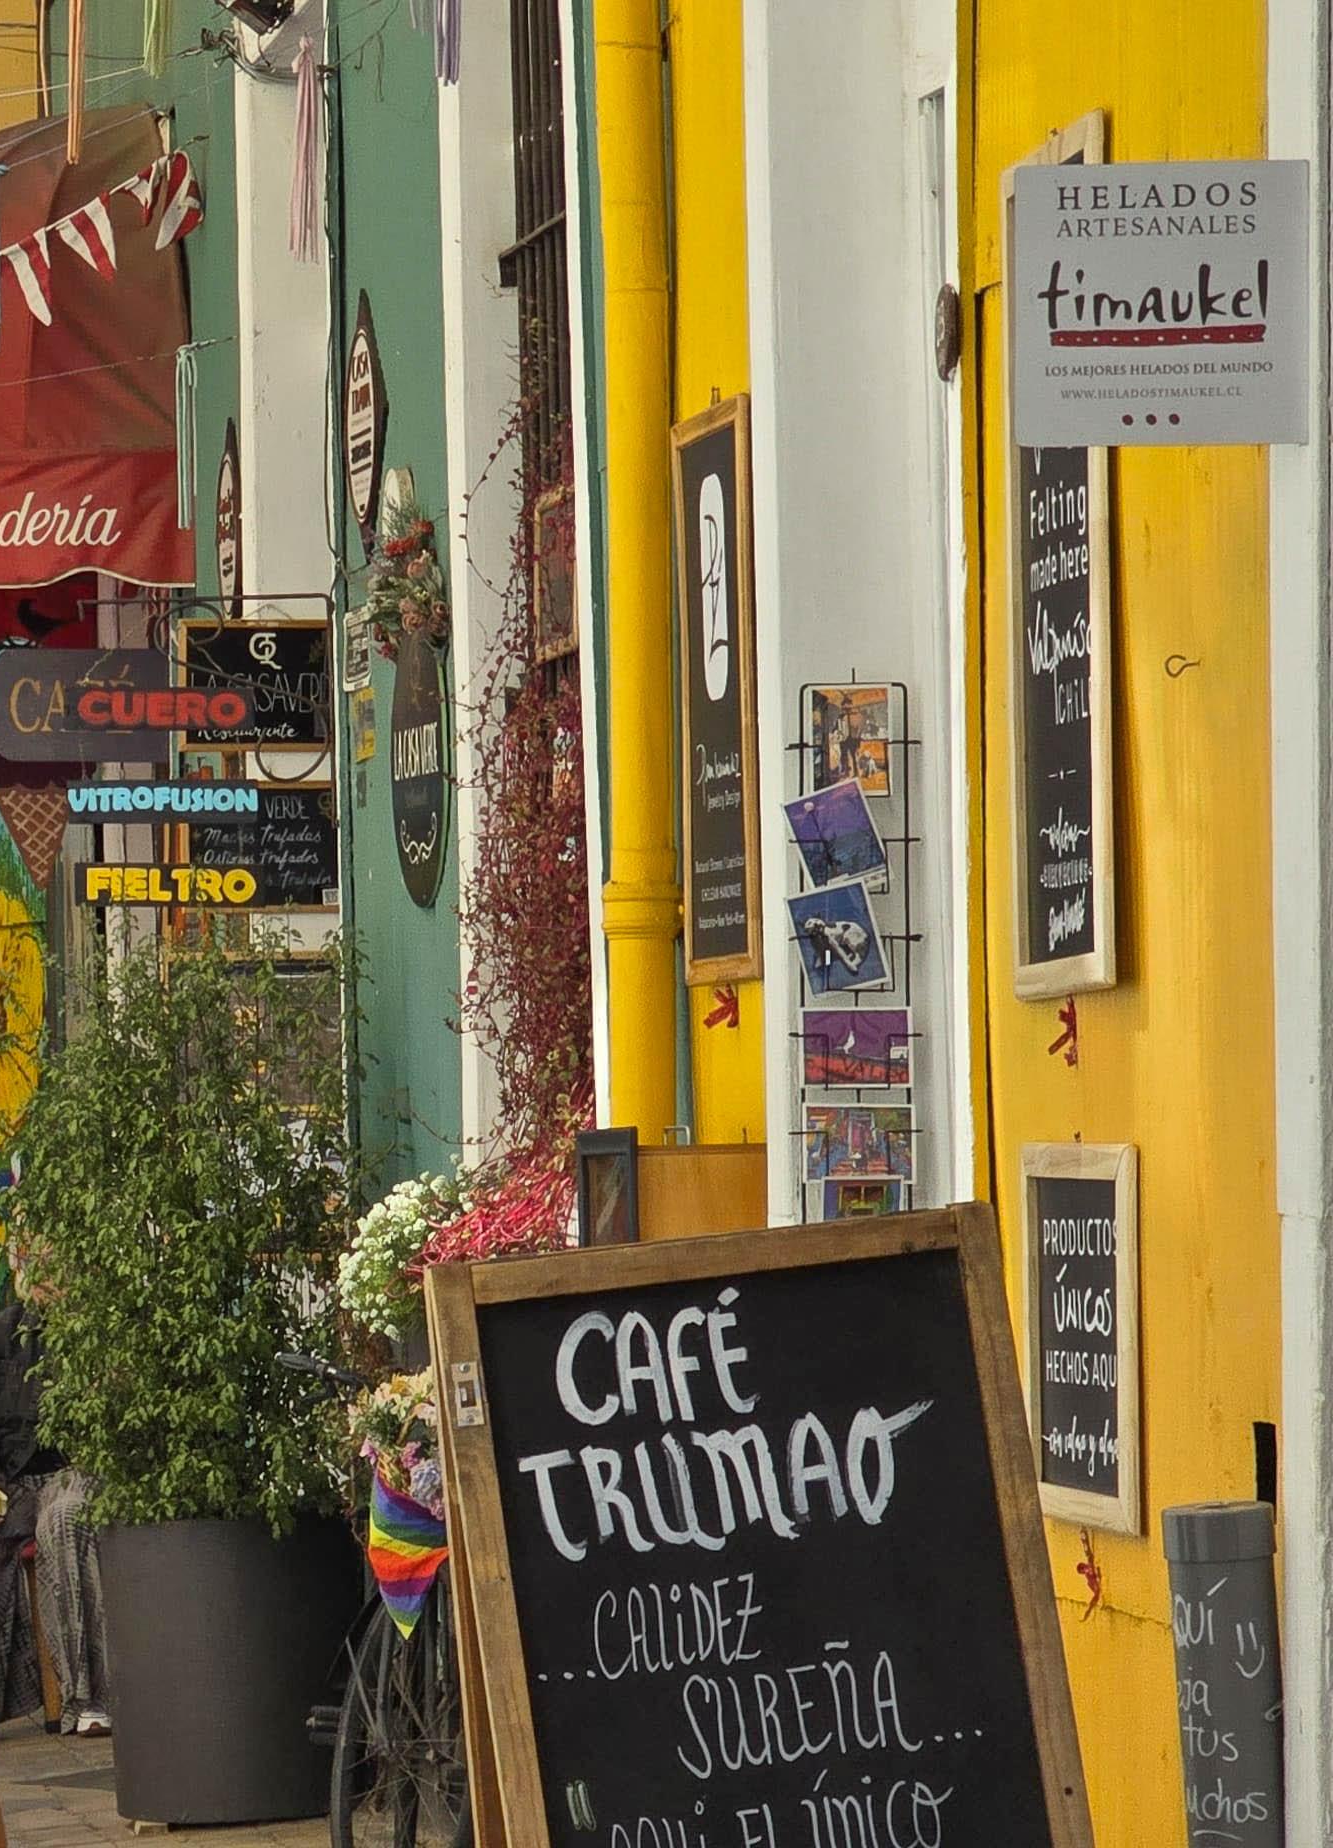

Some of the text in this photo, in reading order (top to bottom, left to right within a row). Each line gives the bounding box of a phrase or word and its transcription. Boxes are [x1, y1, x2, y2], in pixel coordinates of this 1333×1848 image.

[1057, 182, 1257, 210] HELADOS
[1057, 214, 1256, 238] ARTESANALES
[1037, 259, 1269, 330] timaukel
[1045, 361, 1273, 379] LOS MEJORES HELADOS DEL MUNDO
[1061, 387, 1243, 400] WWW.HELADOSTIMAUKEL.CL
[1030, 480, 1087, 539] Felting
[1030, 541, 1089, 592] made here
[77, 690, 246, 728] CUERO
[68, 786, 259, 813] VITROFUSION
[264, 795, 310, 821] VERDE
[86, 867, 257, 903] FIELTRO
[1054, 1263, 1112, 1338] ÚNICOS
[555, 1287, 761, 1425] CAFÉ
[1046, 1350, 1118, 1388] HECHOS AQU
[518, 1399, 933, 1563] TRUMAO
[1173, 1577, 1228, 1648] QUÍ
[1183, 1714, 1239, 1763] tus
[1187, 1777, 1268, 1824] uchos
